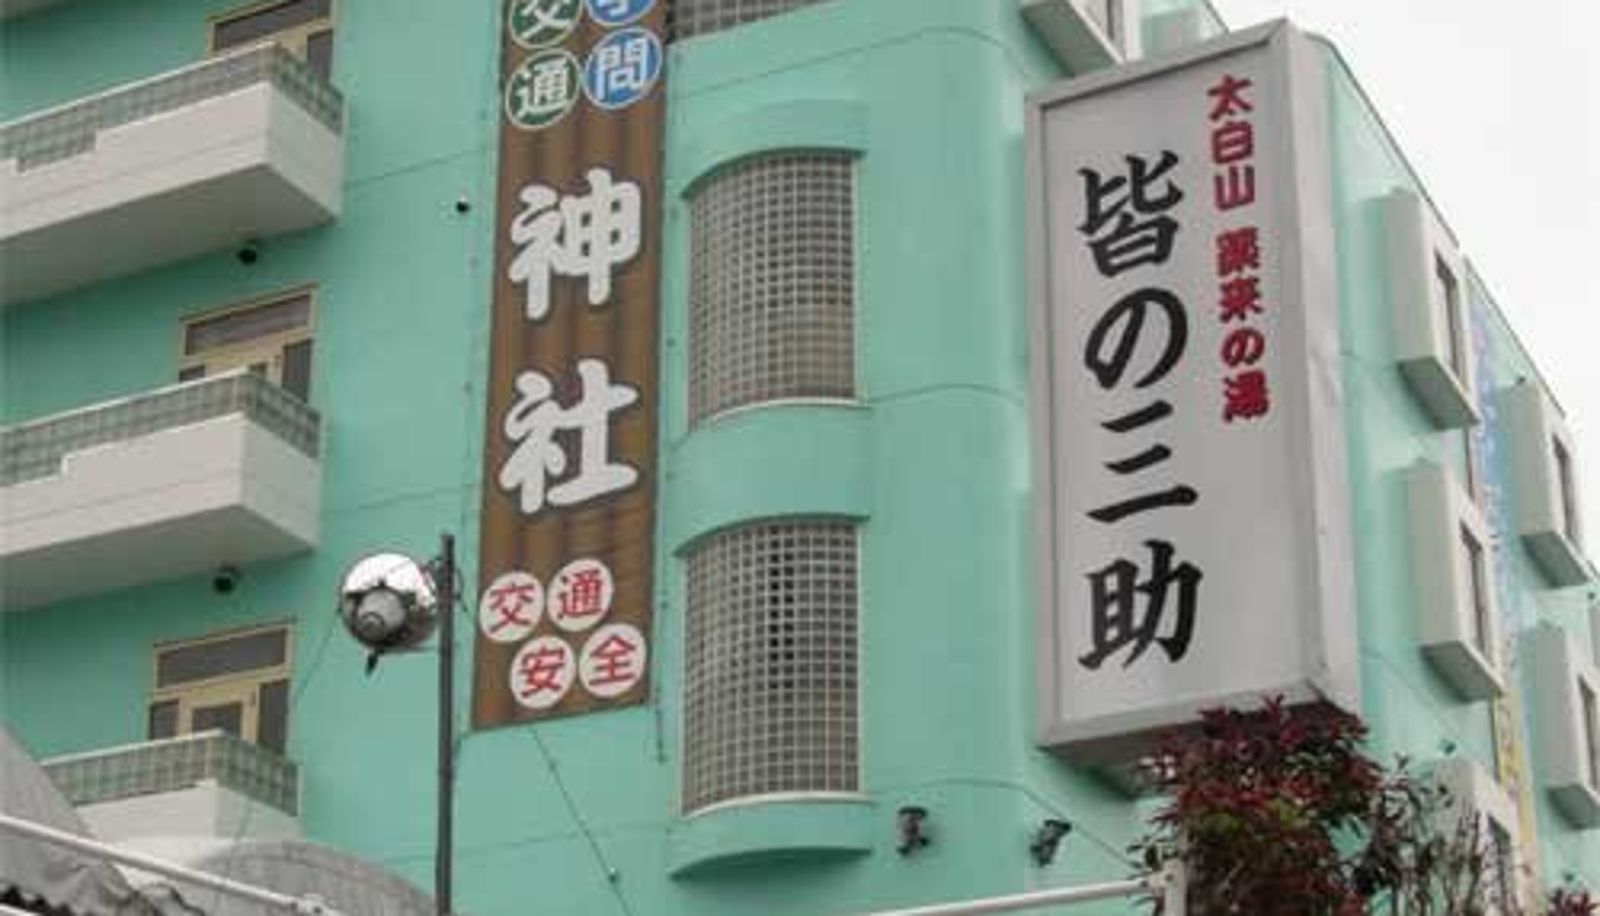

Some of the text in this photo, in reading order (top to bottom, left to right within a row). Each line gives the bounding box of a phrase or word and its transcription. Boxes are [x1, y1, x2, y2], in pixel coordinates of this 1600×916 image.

[596, 0, 648, 102] 問
[1207, 74, 1255, 212] 太白山
[499, 168, 640, 512] 神社
[1078, 149, 1204, 670] 皆の三助
[488, 567, 603, 634] 交通
[520, 633, 637, 697] 安全
